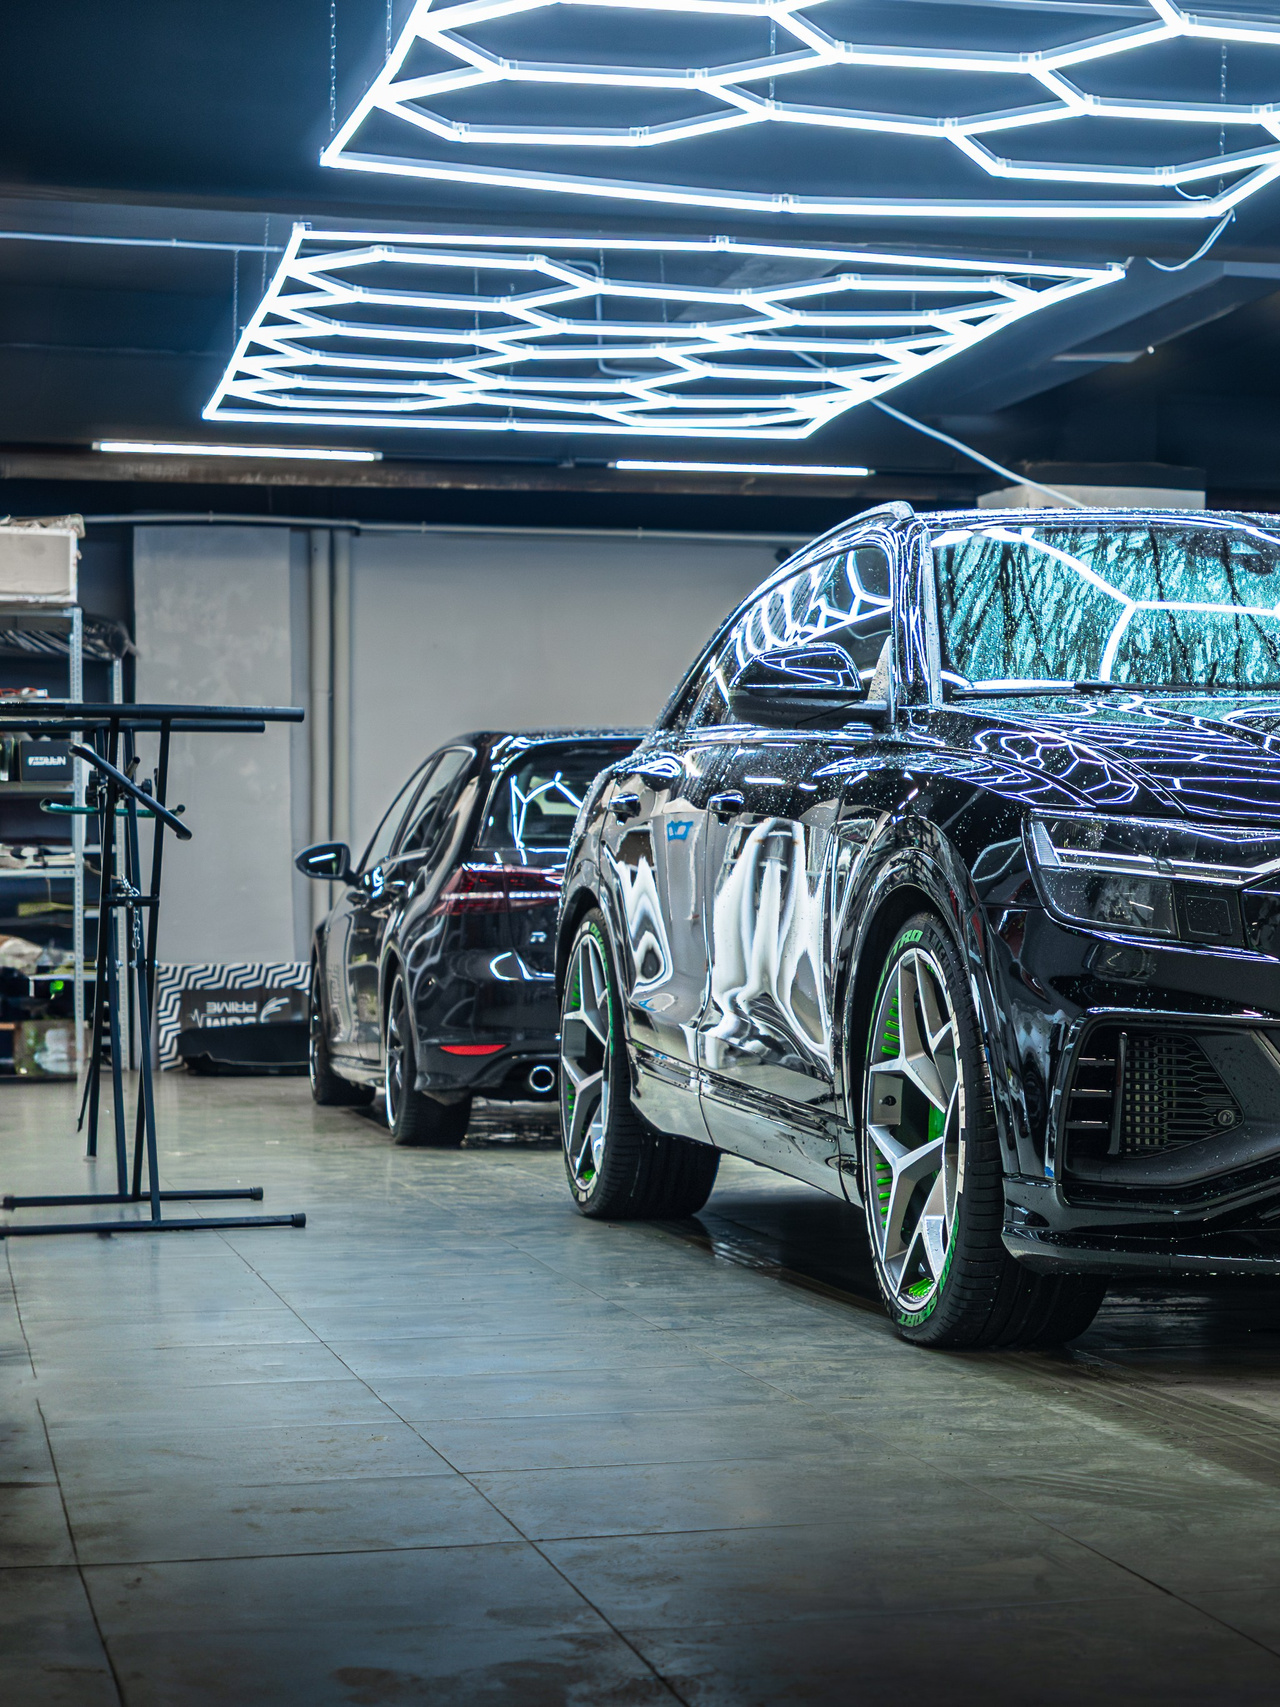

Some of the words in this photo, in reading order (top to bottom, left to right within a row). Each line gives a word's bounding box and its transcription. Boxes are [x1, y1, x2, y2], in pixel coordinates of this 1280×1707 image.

[530, 931, 546, 943] R
[206, 1001, 257, 1014] PRIME
[897, 1290, 938, 1327] SPORT
